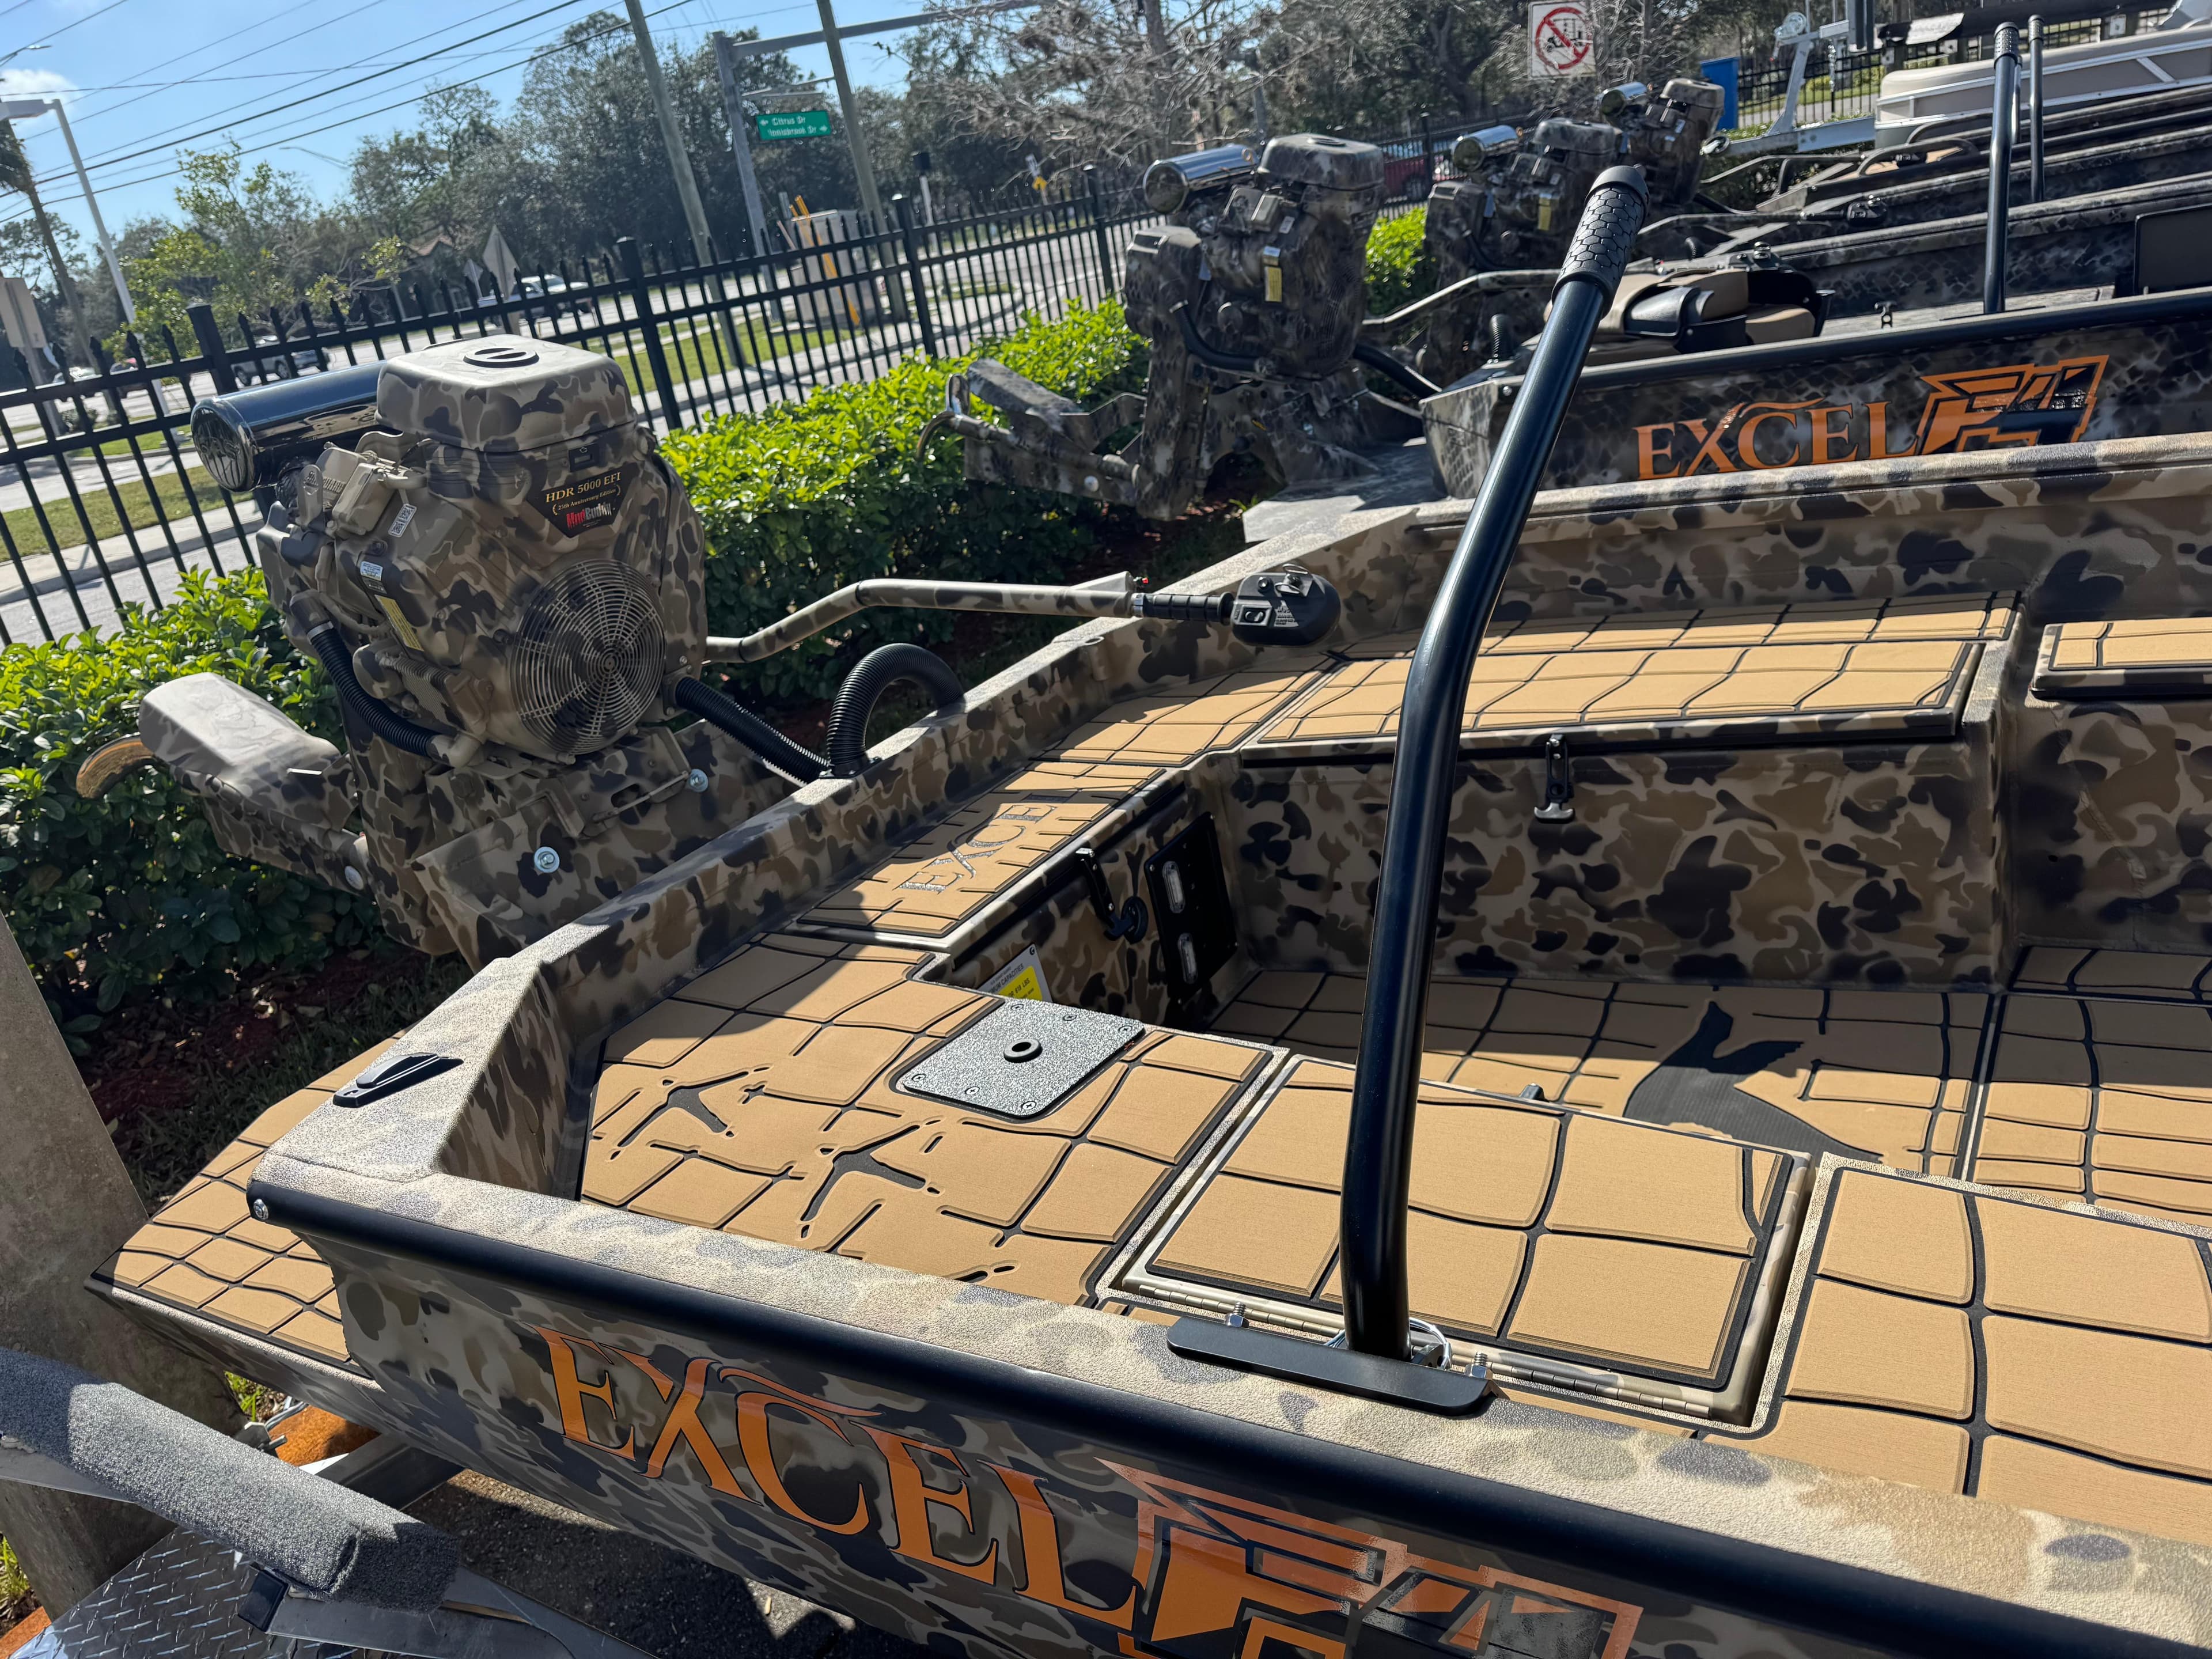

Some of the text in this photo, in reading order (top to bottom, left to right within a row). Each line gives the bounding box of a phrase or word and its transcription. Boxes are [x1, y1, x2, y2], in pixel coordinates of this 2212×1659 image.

[772, 115, 806, 126] Citrus Dr
[807, 125, 817, 134] Dr
[1634, 397, 1922, 480] EXCEL
[546, 472, 621, 503] HDR 5000 EFI
[522, 1323, 1137, 1632] EXCEL
